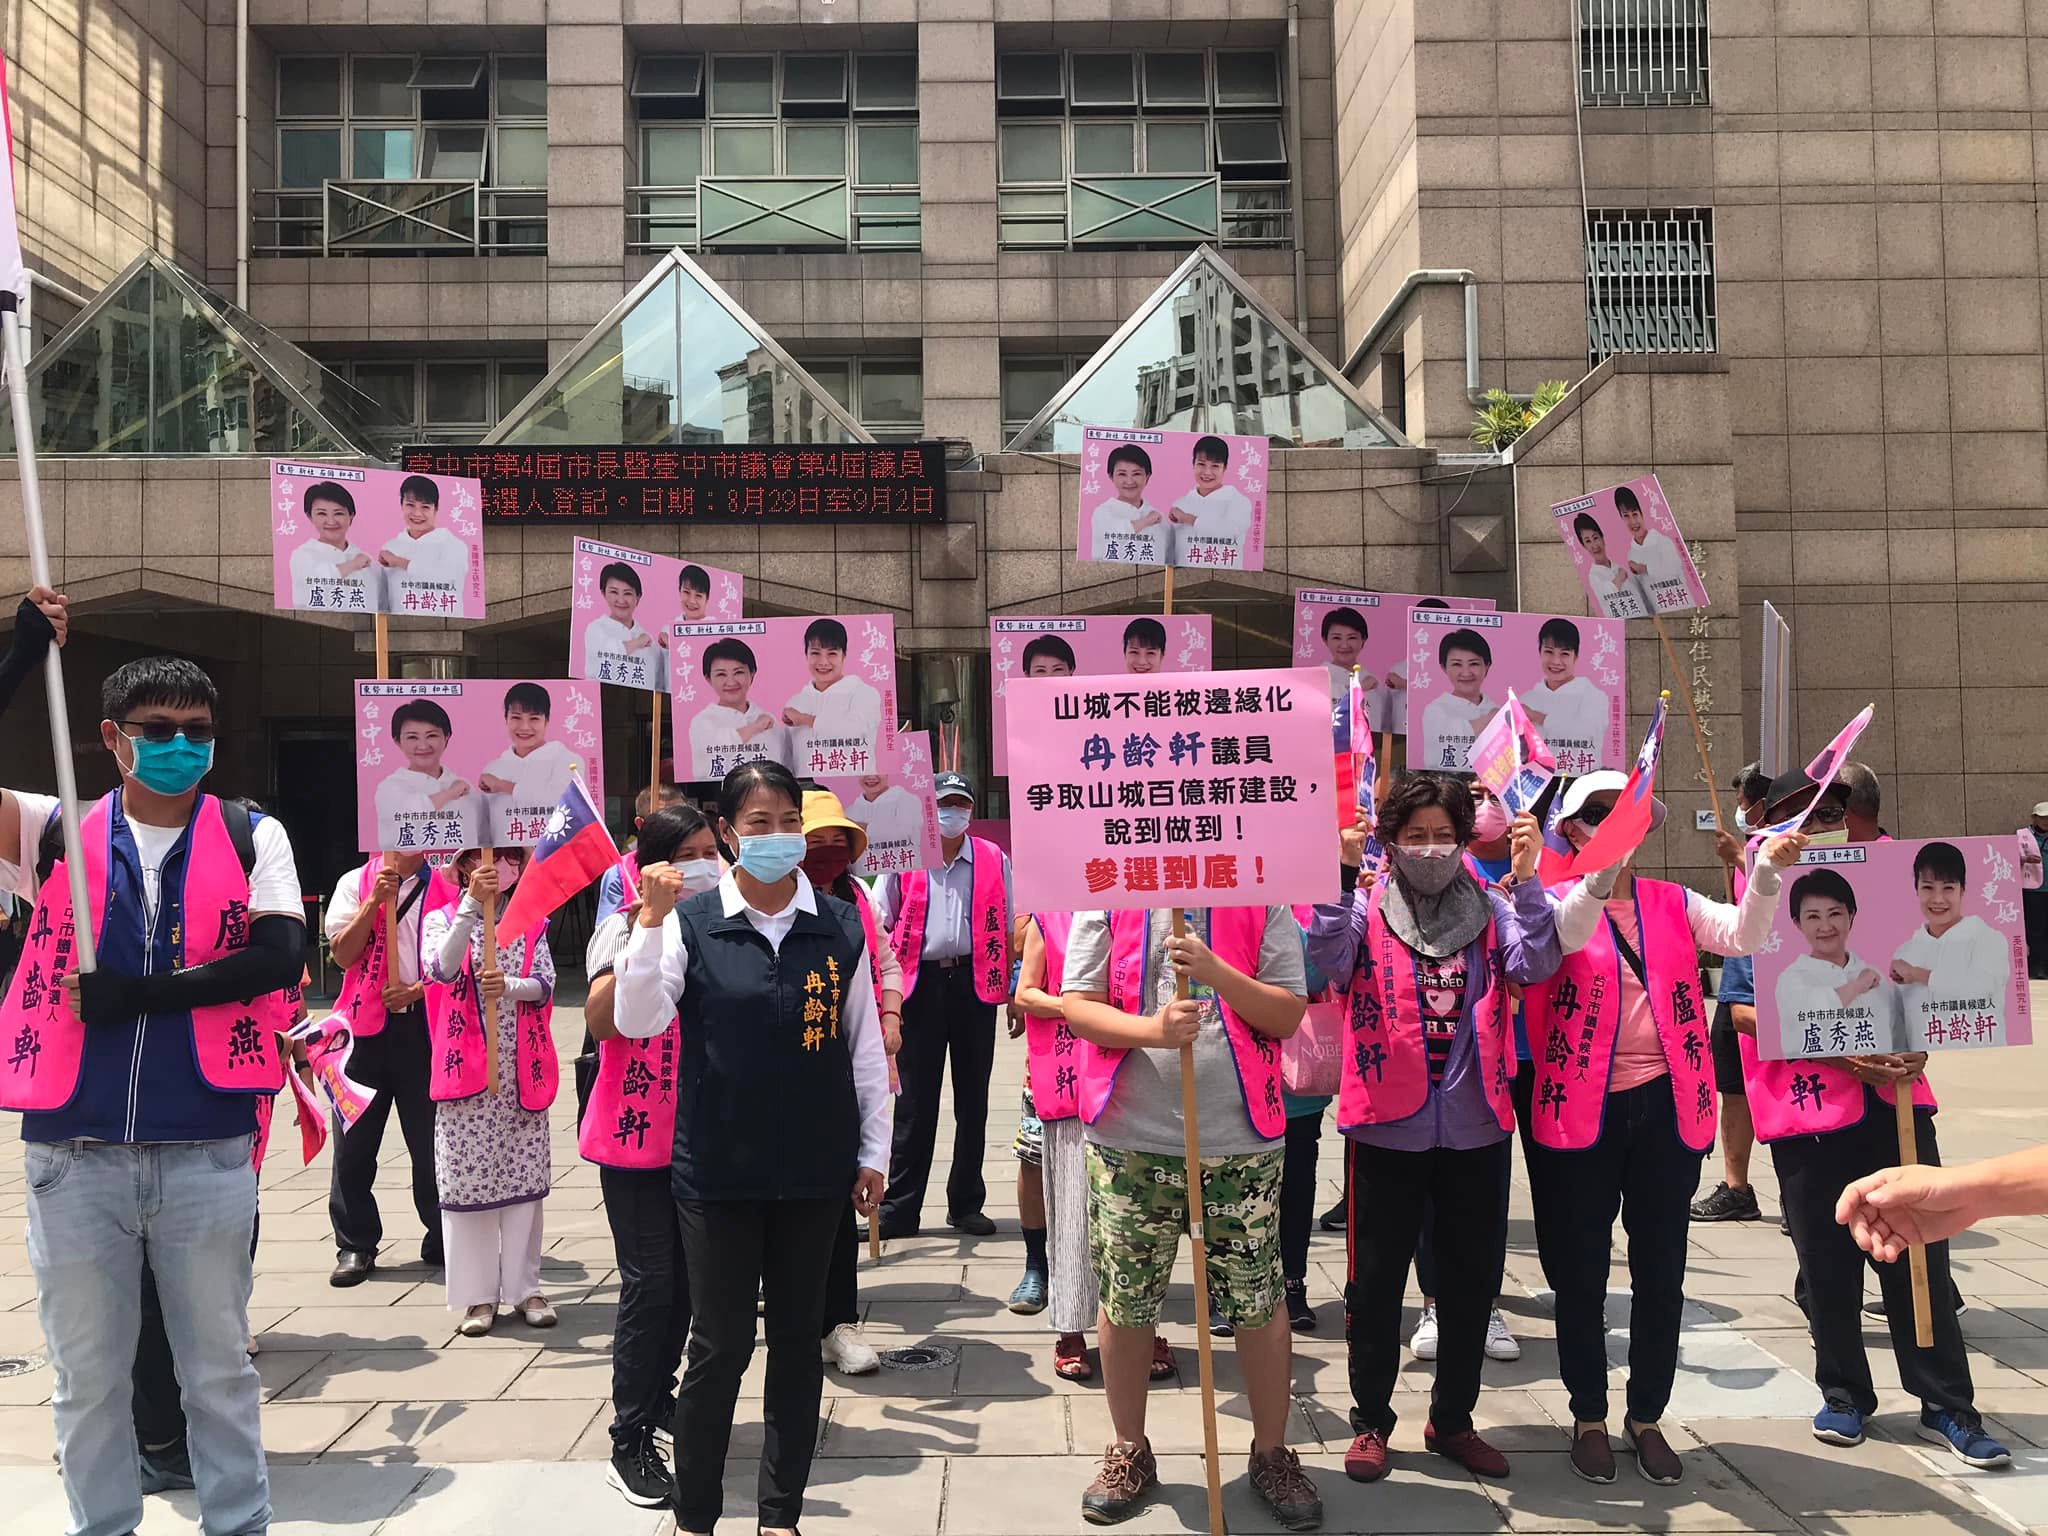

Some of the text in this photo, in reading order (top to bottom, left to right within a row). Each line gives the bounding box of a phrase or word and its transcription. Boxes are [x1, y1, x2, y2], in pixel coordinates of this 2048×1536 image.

[1083, 442, 1101, 495] 台中好
[276, 479, 298, 536] 台中好
[449, 481, 480, 537] 山城更好
[481, 486, 935, 515] 選人登記。日期：8月29日至9月2日
[1104, 542, 1155, 562] 盧秀燕
[1187, 545, 1238, 566] 冉齡軒
[306, 577, 365, 588] 台中市市長候選人
[308, 586, 366, 608] 盧秀燕
[401, 580, 457, 592] 台中市議員候選人
[402, 591, 457, 612] 冉齡軒
[576, 556, 595, 609] 台中好
[718, 575, 739, 620] 山城更
[858, 620, 891, 682] 山城更好
[1177, 620, 1207, 672] 山城更
[1296, 606, 1315, 658] 台中好
[598, 661, 645, 685] 盧秀燕
[676, 641, 697, 703] 台中好
[1411, 628, 1432, 689] 台中好
[1590, 624, 1620, 686] 山城更好
[563, 686, 597, 749] 山城更好
[884, 690, 894, 752] 英國博士研究生
[1054, 686, 1293, 721] 山城不能被邊緣化
[360, 701, 384, 767] 台中好
[706, 743, 768, 753] 台中市市長候選人
[806, 737, 868, 749] 台中市議員候選人
[1544, 738, 1595, 748] 中市議員候選人
[807, 749, 868, 772] 冉齡軒
[902, 736, 930, 789] 山城更好
[1556, 749, 1596, 773] 齡軒
[394, 811, 463, 821] 台中市市長候選人
[397, 821, 463, 847] 盧秀燕
[507, 817, 547, 842] 冉齡
[1104, 815, 1244, 845] 說到做到！
[864, 849, 915, 872] 冉齡軒
[867, 839, 914, 850] 中市議員候選人
[1833, 850, 1862, 861] 和平區
[1085, 854, 1265, 893] 參選到底！
[1981, 844, 2020, 924] 山城更好
[984, 906, 1003, 994] 盧秀燕
[214, 899, 267, 1070] 盧燕
[2013, 935, 2027, 1015] 英國博士研究生
[801, 969, 827, 1052] 冉齡軒
[1797, 1008, 1874, 1021] 台中市市長候選人
[1921, 999, 1996, 1012] 台中市議員候選人
[1538, 975, 1582, 1122] 冉齡軒
[1575, 973, 1606, 1082] 台中市議員候選人
[1802, 1021, 1876, 1053] 盧秀燕
[1924, 1012, 1998, 1045] 冉齡軒
[658, 1026, 675, 1105] 市議員候選人
[1055, 1022, 1077, 1100] 齡軒
[1671, 980, 1714, 1125] 盧秀燕
[613, 1038, 658, 1150] 齡軒
